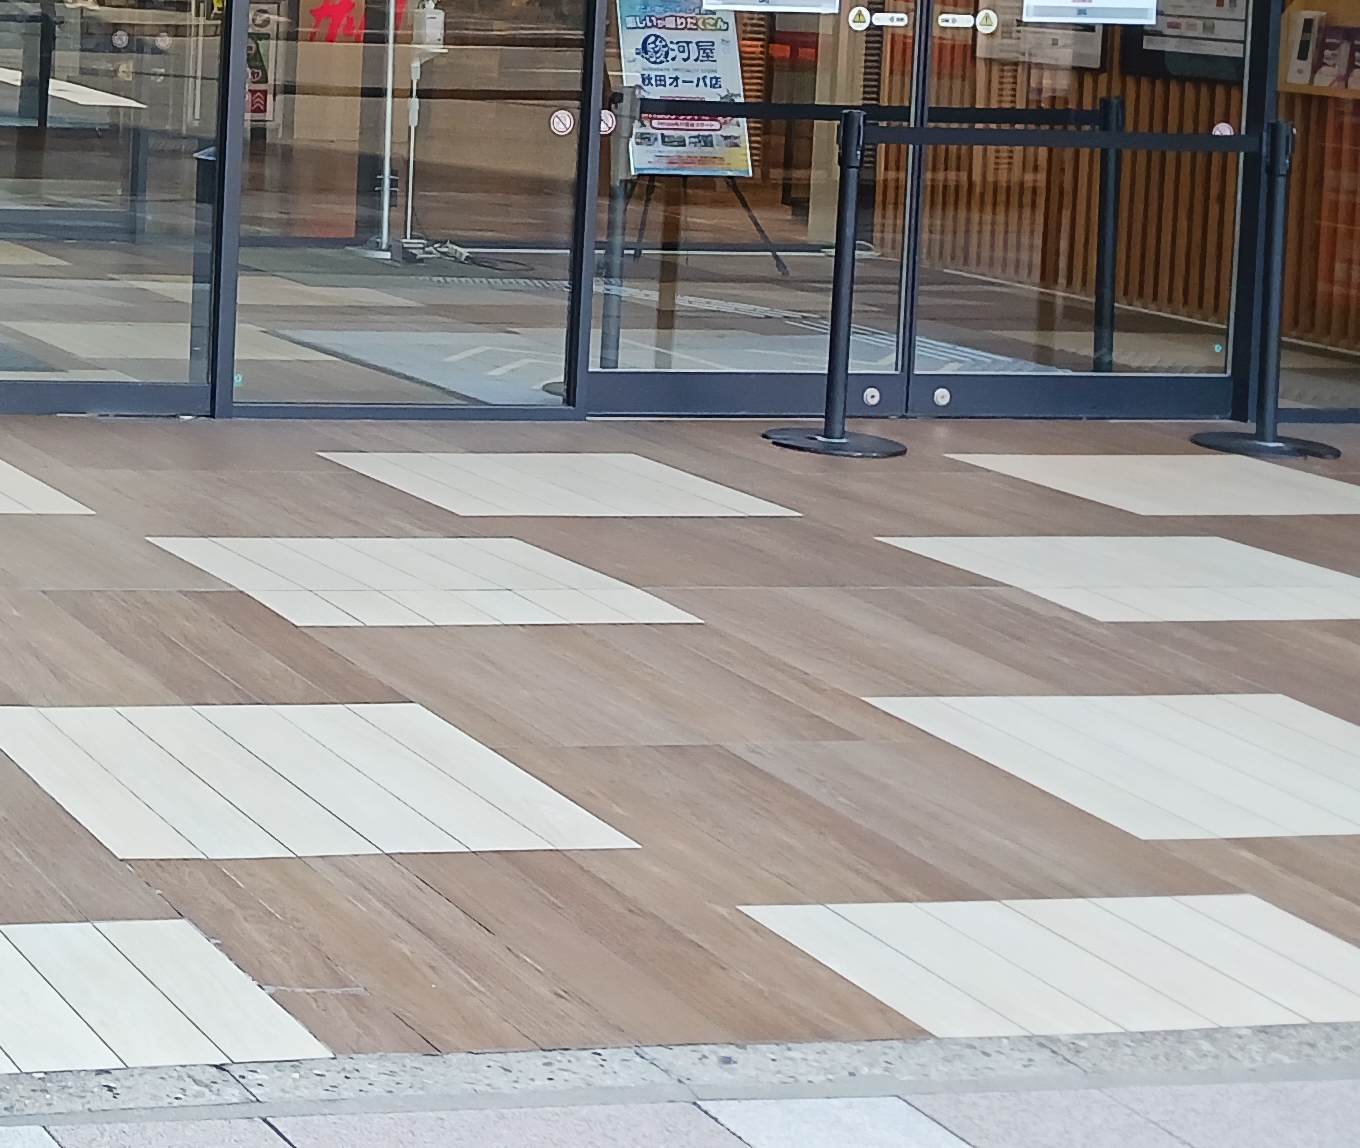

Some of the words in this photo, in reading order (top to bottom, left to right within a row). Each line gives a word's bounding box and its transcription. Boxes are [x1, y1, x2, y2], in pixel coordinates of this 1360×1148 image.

[640, 73, 723, 89] 秋田オーパ店
